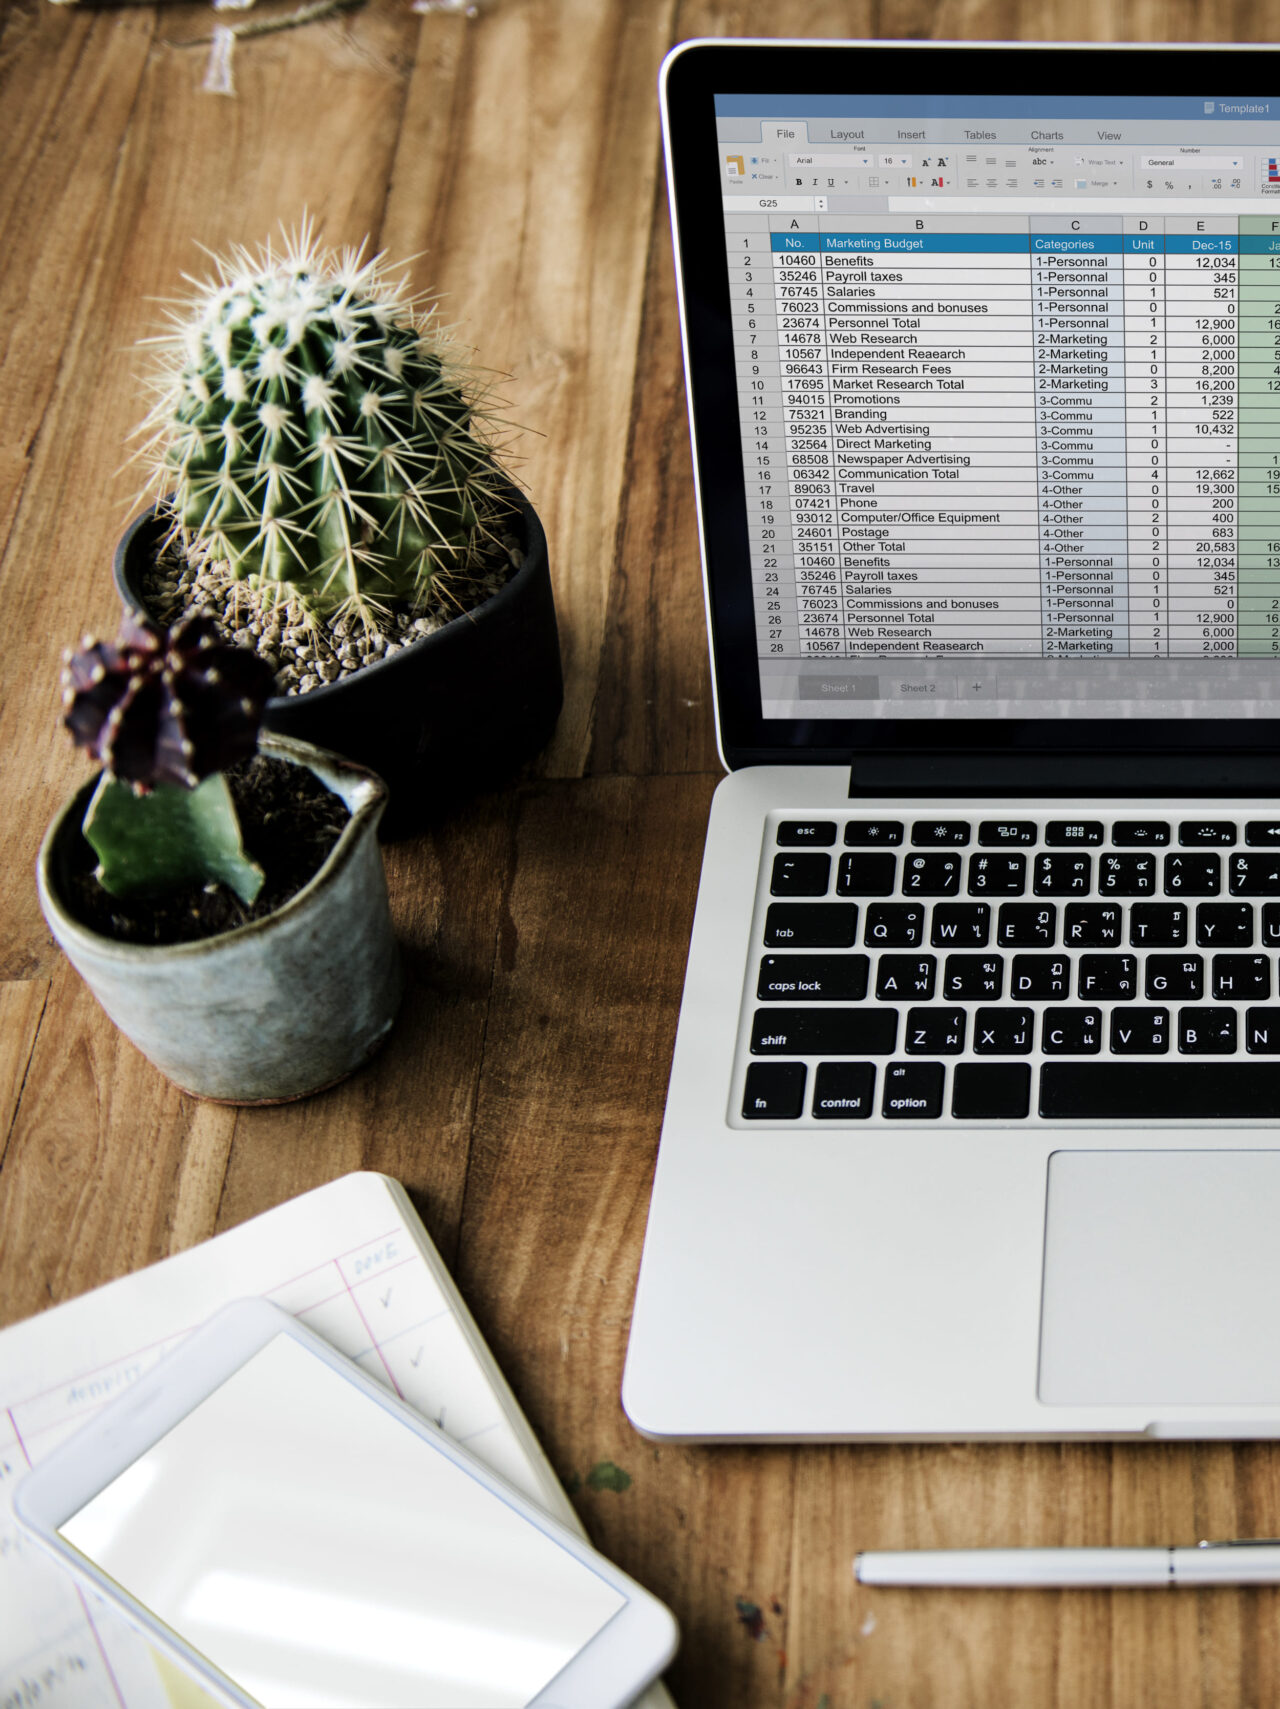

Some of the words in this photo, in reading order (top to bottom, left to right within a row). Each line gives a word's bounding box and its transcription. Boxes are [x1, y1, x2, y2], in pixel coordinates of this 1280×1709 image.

[1219, 104, 1268, 114] Template1
[776, 129, 795, 139] File
[831, 130, 864, 140] Layout
[898, 130, 926, 139] Insert
[964, 130, 996, 140] Tables
[1031, 131, 1064, 140] Charts
[1098, 131, 1121, 140] View
[796, 157, 813, 165] Arial
[883, 157, 893, 165] 16
[1031, 157, 1047, 166] abc
[1147, 159, 1175, 167] General
[759, 199, 778, 208] G25
[786, 238, 804, 247] No.
[827, 238, 880, 250] Marketing
[884, 239, 923, 250] Budget
[1036, 239, 1094, 251] Categories
[1133, 240, 1154, 249] Unit
[1192, 241, 1232, 250] Dec-15
[780, 255, 815, 265] 10460
[826, 256, 874, 266] Benefits
[1037, 256, 1107, 268] 1-Personnal
[1196, 258, 1236, 269] 12,034
[780, 271, 816, 281] 35246
[826, 271, 866, 284] Payroll
[871, 272, 902, 281] taxes
[780, 287, 818, 297] 76745
[827, 286, 875, 296] Salaries
[782, 302, 818, 312] 76023
[828, 302, 908, 312] Commissions
[912, 303, 934, 312] and
[938, 303, 988, 313] bonuses
[783, 318, 819, 328] 23674
[829, 318, 888, 328] Personnel
[892, 318, 920, 328] Total
[1196, 319, 1235, 330] 12,900
[830, 334, 857, 343] Web
[861, 334, 917, 343] Research
[1038, 334, 1107, 346] 2-Marketing
[831, 349, 904, 361] Independent
[908, 349, 965, 359] Reaearch
[832, 364, 858, 373] Firm
[862, 364, 918, 374] Research
[922, 364, 951, 374] Fees
[833, 379, 873, 389] Market
[877, 379, 933, 389] Research
[936, 380, 964, 389] Total
[834, 394, 900, 404] Promotions
[1040, 396, 1092, 405] 3-Commu
[835, 409, 887, 422] Branding
[835, 424, 862, 434] Web
[865, 424, 929, 437] Advertising
[837, 439, 870, 448] Direct
[874, 439, 931, 452] Marketing
[838, 454, 904, 467] Newspaper
[906, 454, 970, 467] Advertising
[838, 469, 928, 478] Communication
[932, 469, 959, 478] Total
[1196, 470, 1234, 480] 12,662
[839, 483, 874, 493] Travel
[1042, 485, 1082, 494] 4-Other
[840, 498, 877, 507] Phone
[841, 512, 934, 525] Computer/Office
[939, 513, 1000, 525] Equipment
[842, 527, 889, 540] Postage
[843, 542, 875, 551] Other
[878, 542, 905, 551] Total
[821, 683, 849, 693] Sheet
[851, 683, 856, 693] 1
[900, 683, 929, 693] Sheet
[929, 683, 937, 693] 2
[776, 928, 794, 937] tab
[874, 925, 887, 937] Q
[941, 925, 957, 937] W
[1006, 925, 1014, 937] E
[1072, 925, 1082, 937] R
[1138, 925, 1148, 937] T
[1205, 924, 1215, 937] Y
[769, 983, 795, 992] caps
[798, 981, 821, 990] lock
[761, 1035, 786, 1045] shift
[893, 1068, 905, 1076] alt
[756, 1098, 766, 1108] fn
[821, 1098, 860, 1107] control
[890, 1098, 926, 1109] option
